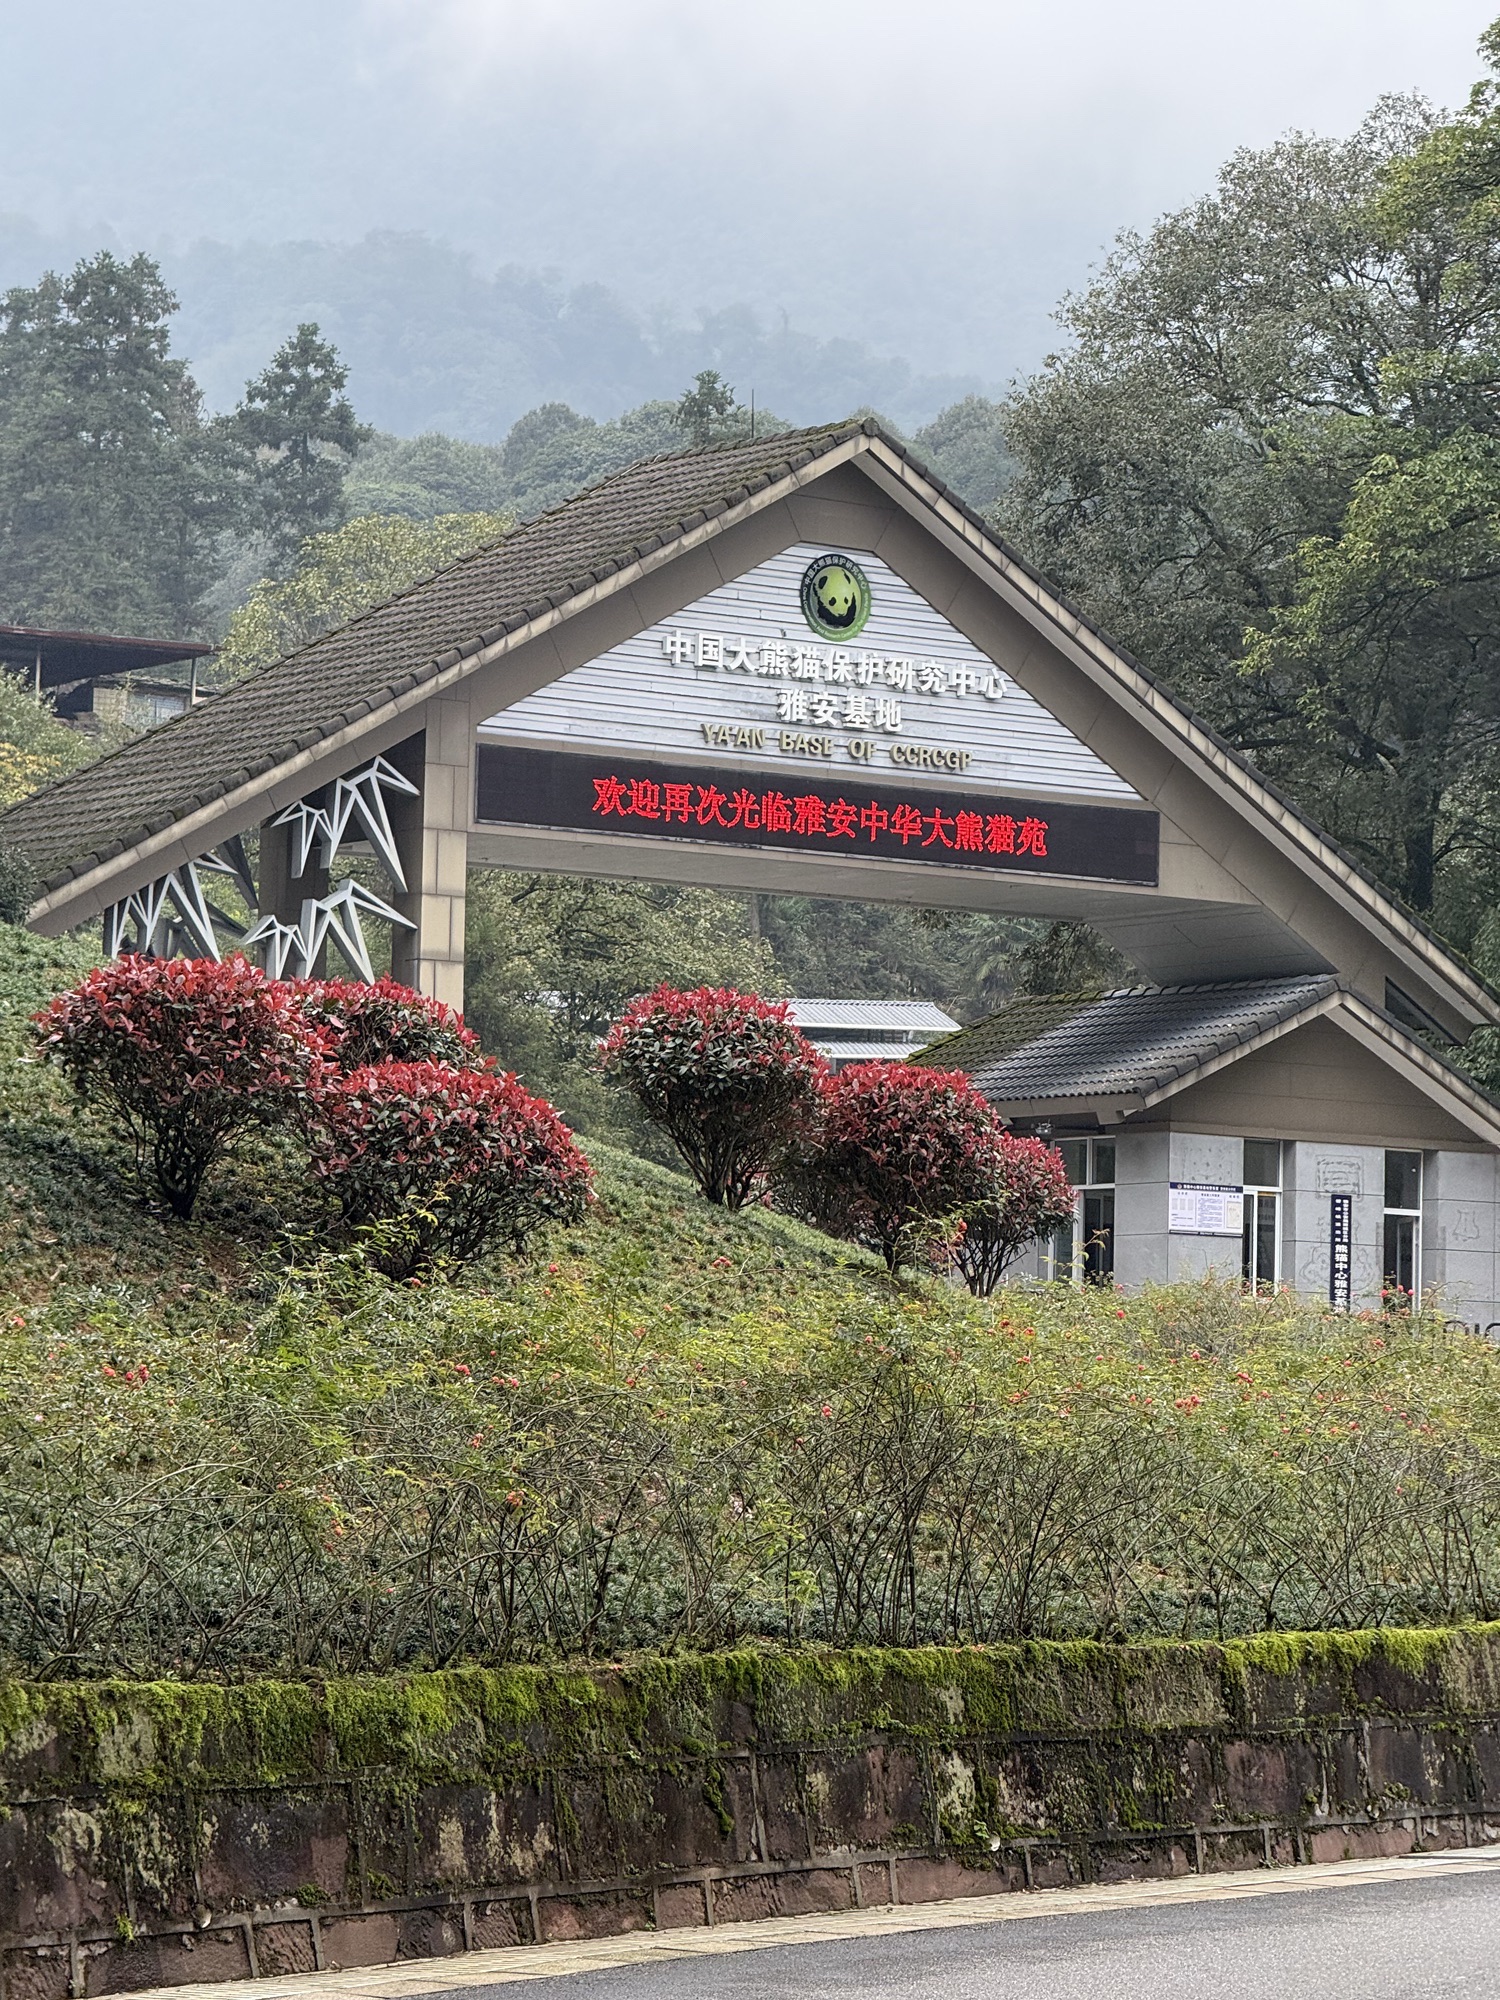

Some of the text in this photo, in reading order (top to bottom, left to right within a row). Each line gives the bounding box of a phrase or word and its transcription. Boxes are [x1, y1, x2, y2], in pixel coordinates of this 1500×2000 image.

[662, 629, 1008, 699] 中国大熊猫保护研究中心
[776, 688, 903, 733] 雅安基地
[780, 730, 835, 756] BASE
[848, 738, 878, 760] OF
[890, 743, 973, 770] CCRCGP
[592, 775, 1049, 857] 欢迎再次光临雅安中华大熊猫苑
